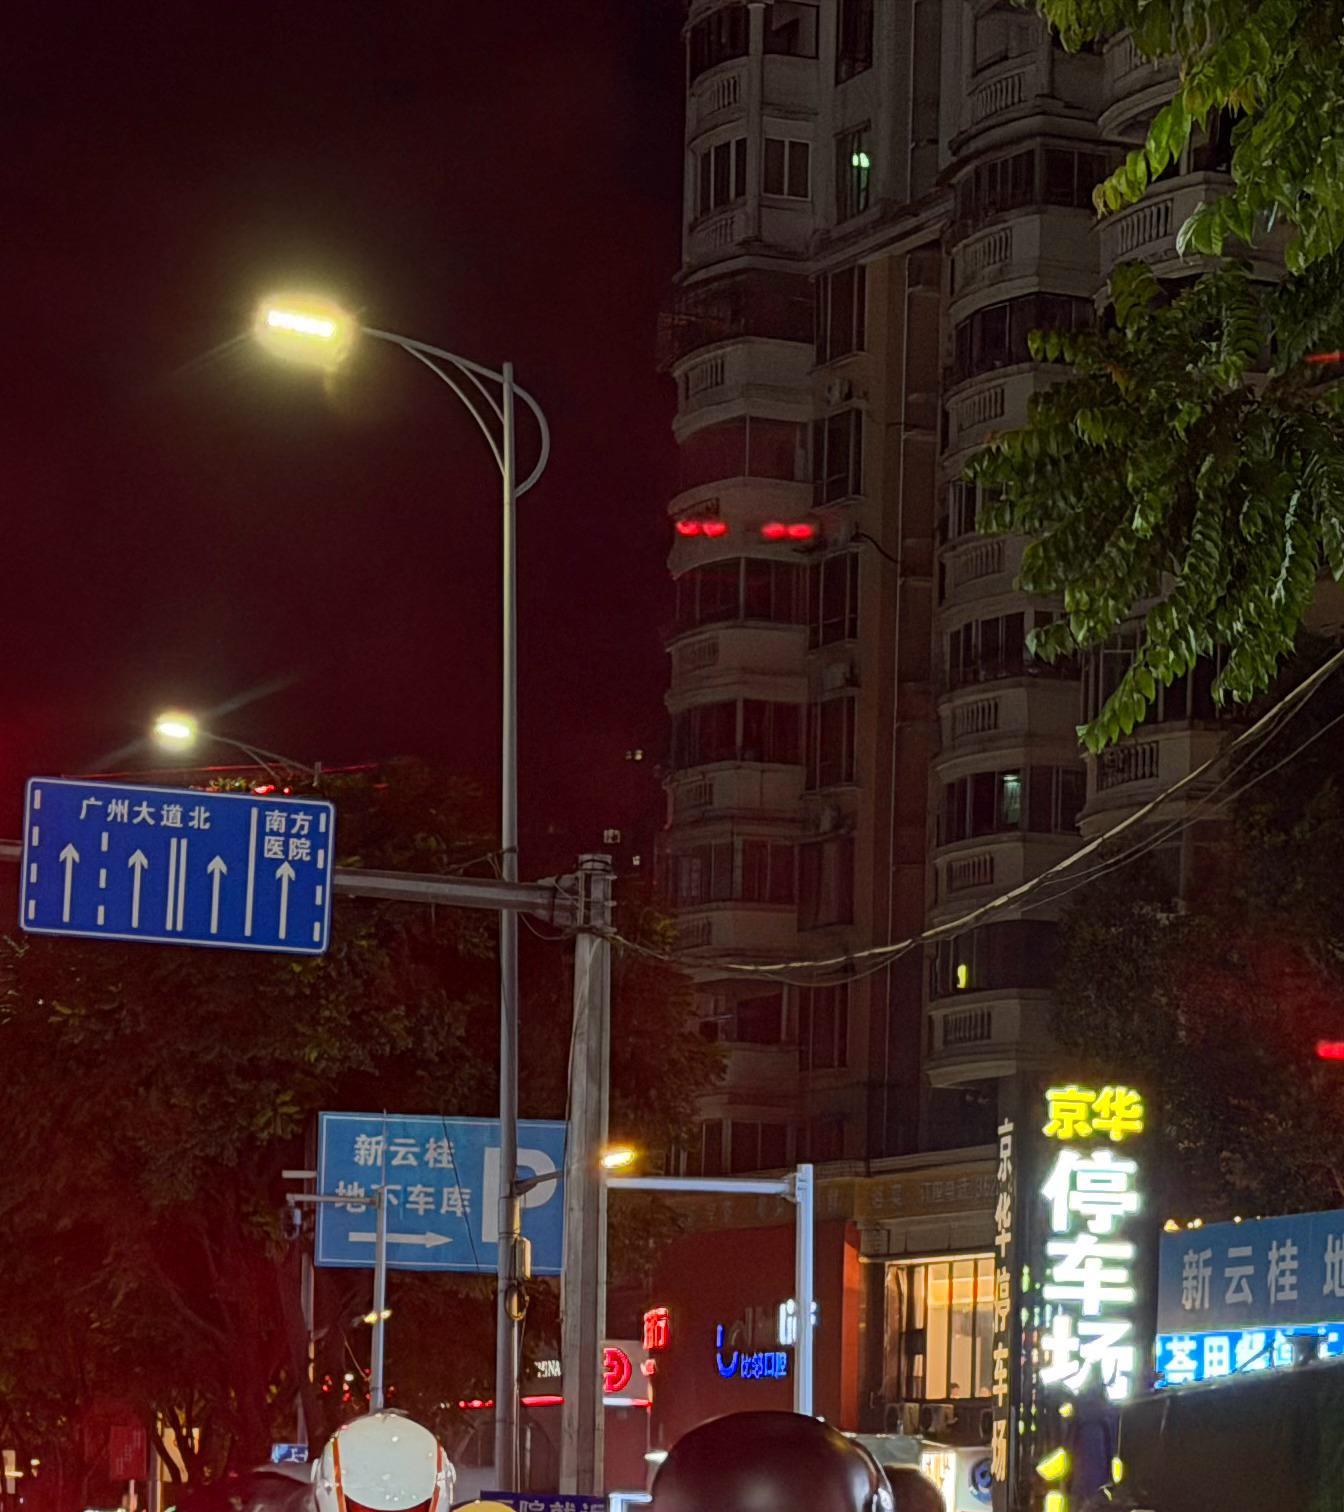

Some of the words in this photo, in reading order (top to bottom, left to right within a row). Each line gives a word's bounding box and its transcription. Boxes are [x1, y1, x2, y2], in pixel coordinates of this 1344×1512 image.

[80, 797, 211, 830] 广州大道北
[265, 810, 313, 834] 南方
[264, 836, 312, 861] 医院
[1042, 1085, 1144, 1142] 京华
[353, 1134, 456, 1169] 新云桂
[1040, 1149, 1142, 1404] 停车场
[1181, 1238, 1299, 1311] 新云桂
